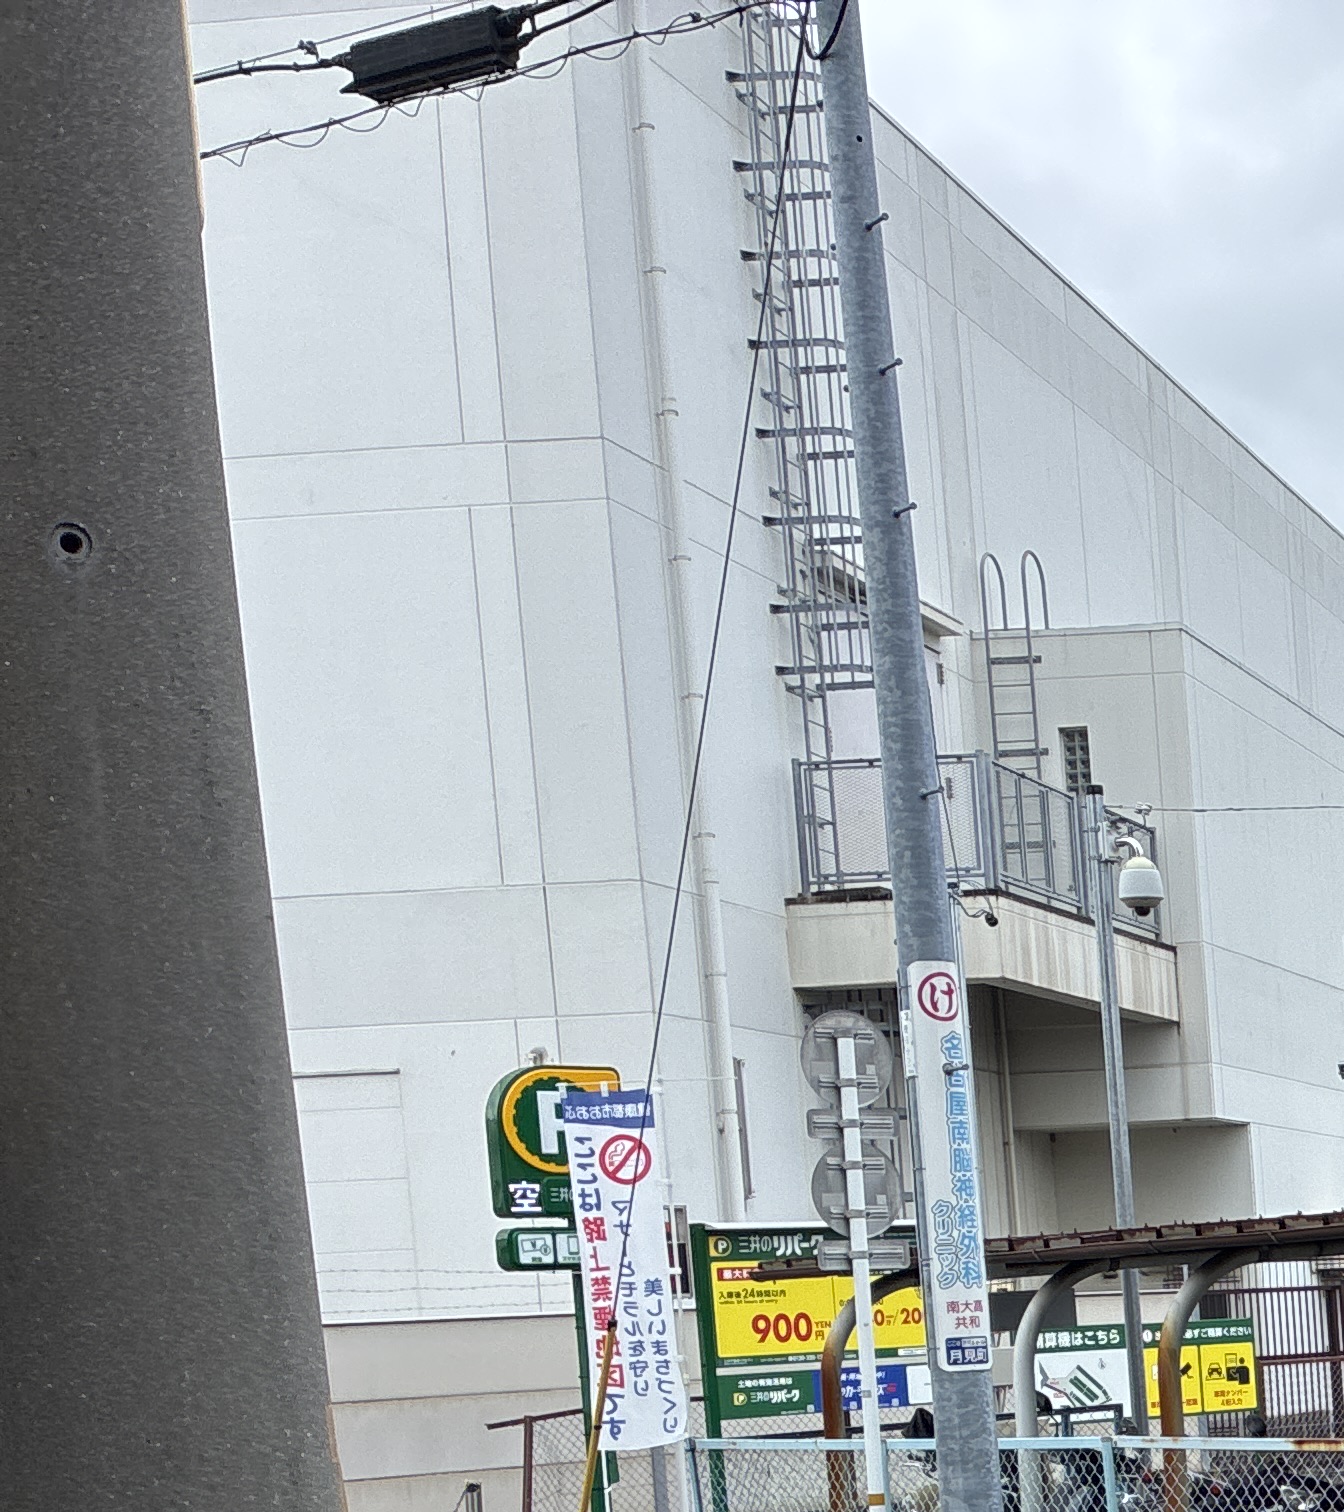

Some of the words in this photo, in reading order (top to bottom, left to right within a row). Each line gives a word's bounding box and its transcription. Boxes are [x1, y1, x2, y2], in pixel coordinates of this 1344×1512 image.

[508, 1180, 542, 1212] 空
[932, 1201, 958, 1289] クリニック
[751, 1311, 812, 1343] 900
[814, 1320, 831, 1328] YEN
[955, 1316, 981, 1330] 共和
[815, 1330, 825, 1341] 円
[950, 1348, 987, 1363] 月見町
